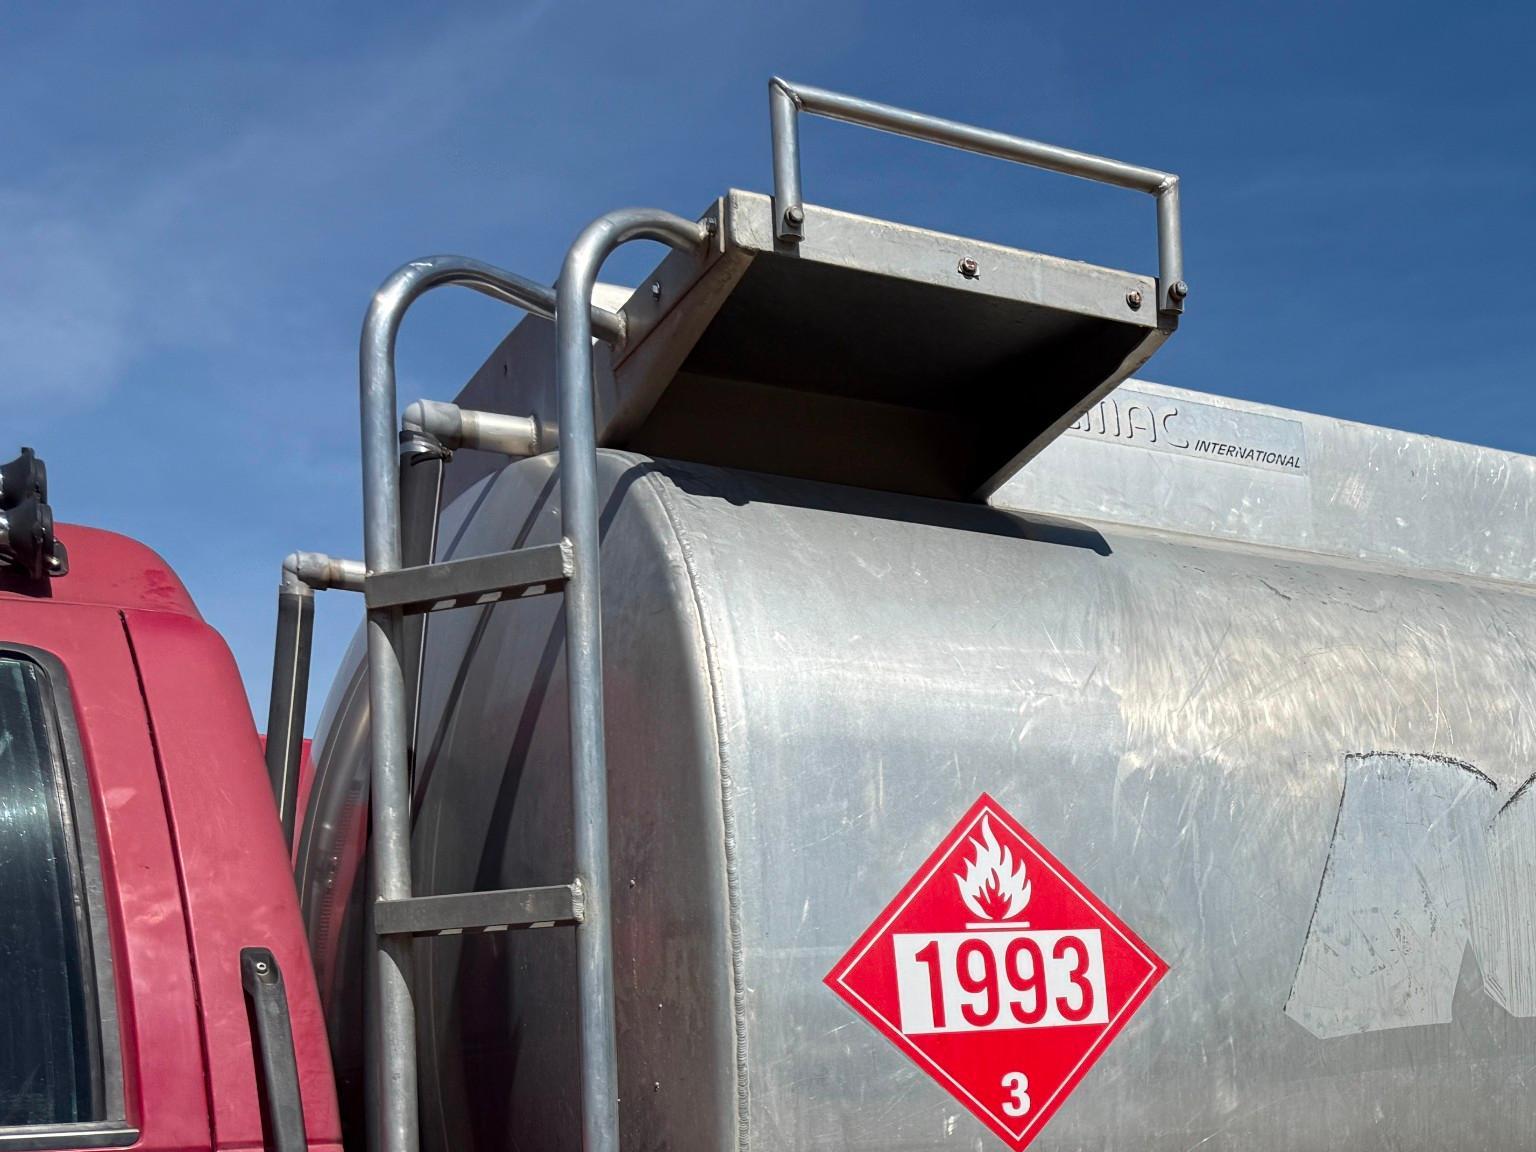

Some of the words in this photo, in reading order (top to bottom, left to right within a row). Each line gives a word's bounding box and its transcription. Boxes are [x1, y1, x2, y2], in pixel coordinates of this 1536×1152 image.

[1194, 439, 1301, 469] INTERNATIONAL
[915, 934, 1095, 1028] 1993
[1001, 1071, 1031, 1117] 3
